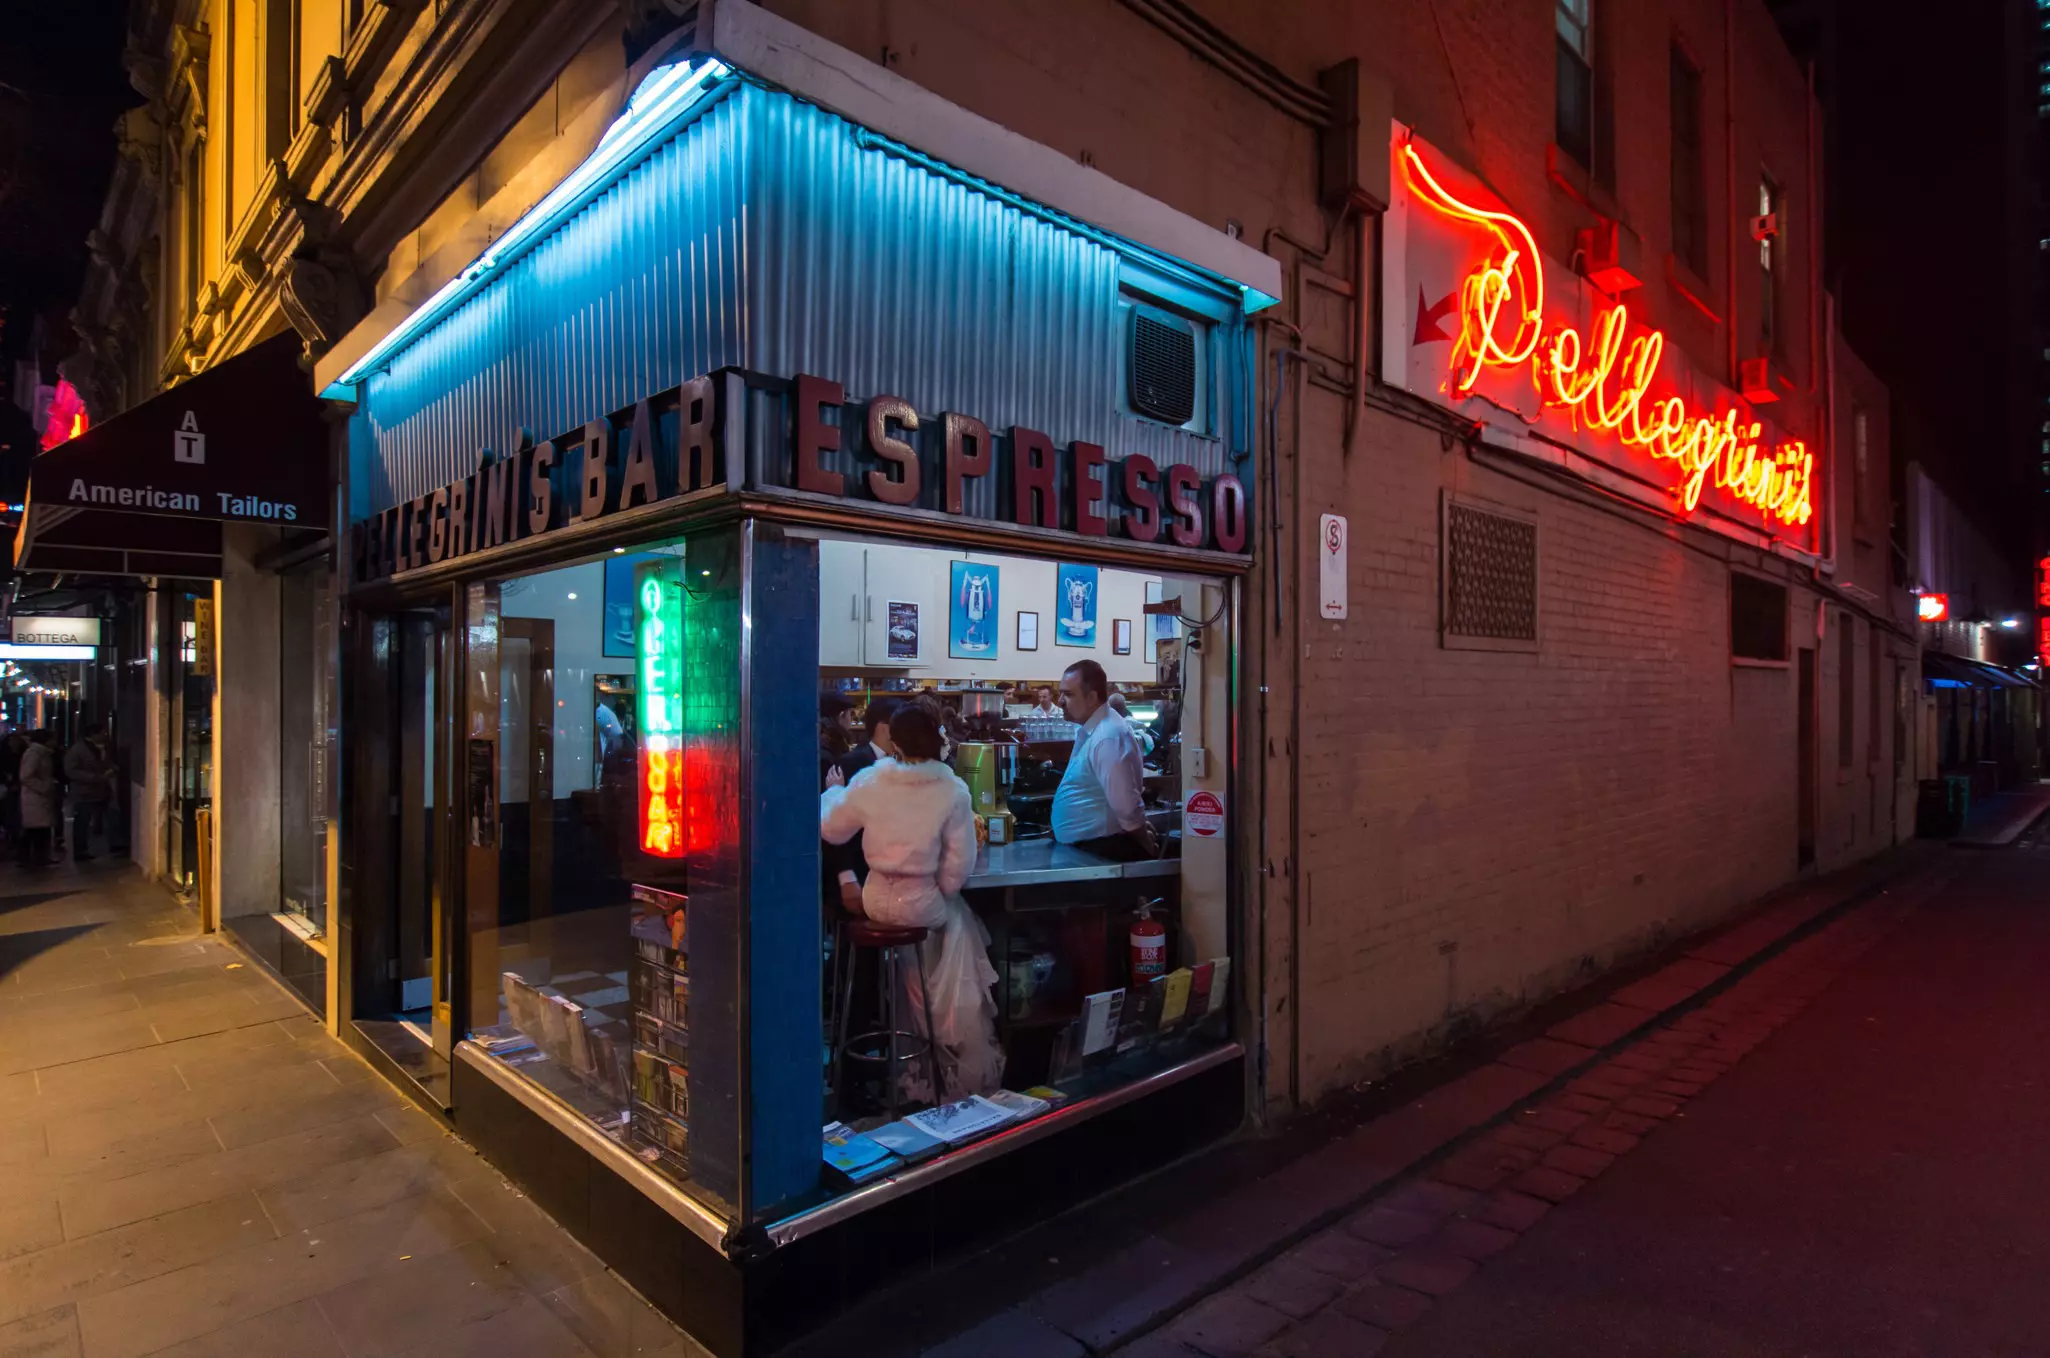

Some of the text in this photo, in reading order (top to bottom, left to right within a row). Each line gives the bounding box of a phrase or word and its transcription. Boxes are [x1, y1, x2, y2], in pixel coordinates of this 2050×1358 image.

[181, 410, 199, 432] A
[180, 436, 198, 458] T
[580, 375, 716, 522] BAR
[794, 373, 1246, 554] ESPRESSO
[68, 478, 297, 521] American Tailors
[17, 633, 79, 643] BOTTEGA
